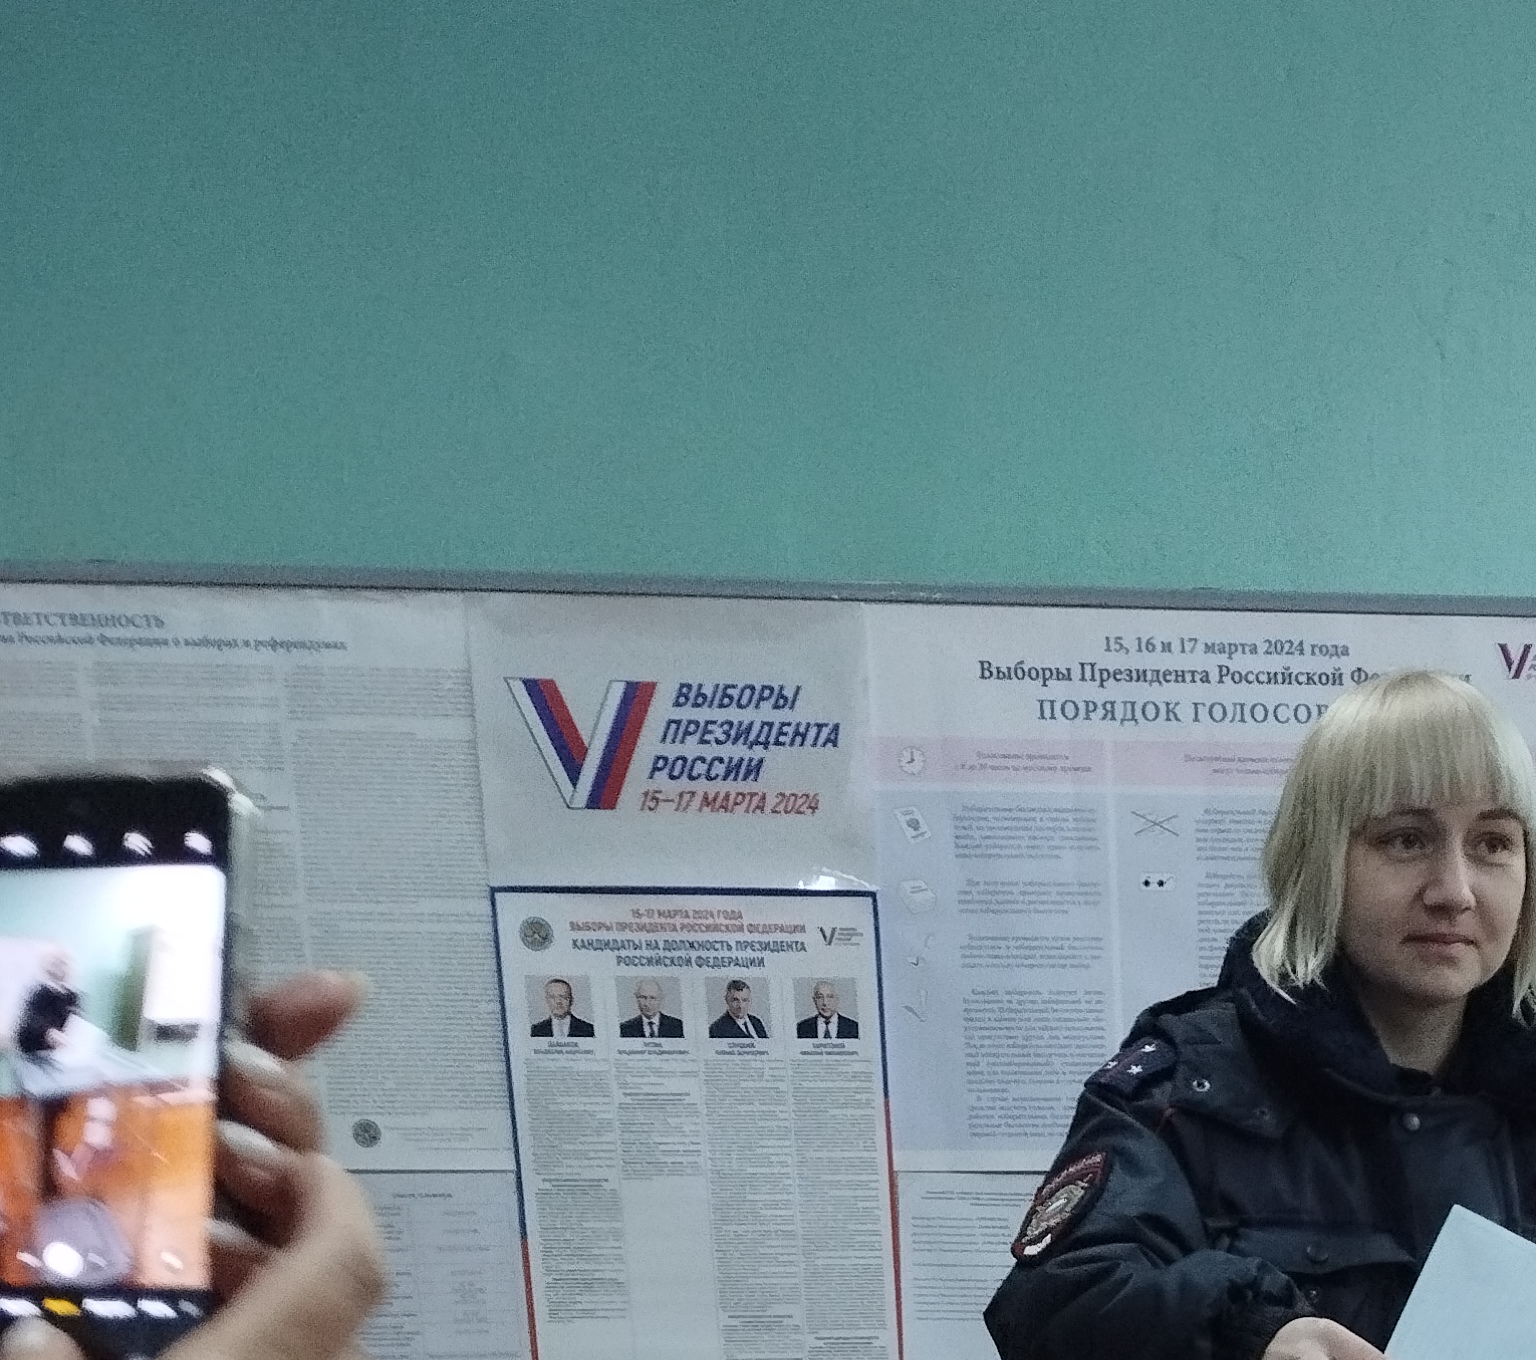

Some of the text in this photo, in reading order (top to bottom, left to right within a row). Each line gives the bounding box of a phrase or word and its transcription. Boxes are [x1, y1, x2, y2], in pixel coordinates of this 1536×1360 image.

[1104, 635, 1350, 660] 15, 16 и 17 марта 2024 года
[978, 660, 1072, 687] Выборы
[1078, 661, 1211, 688] Президента
[1217, 664, 1344, 687] Российской
[672, 682, 802, 712] ВЫБОРЫ
[1036, 699, 1182, 726] ПОРЯДОК
[660, 718, 840, 750] ПРЕЗИДЕНТА
[647, 754, 765, 782] РОССИИ
[698, 791, 767, 814] МАРТА
[770, 791, 820, 815] 2024
[644, 939, 661, 951] НА
